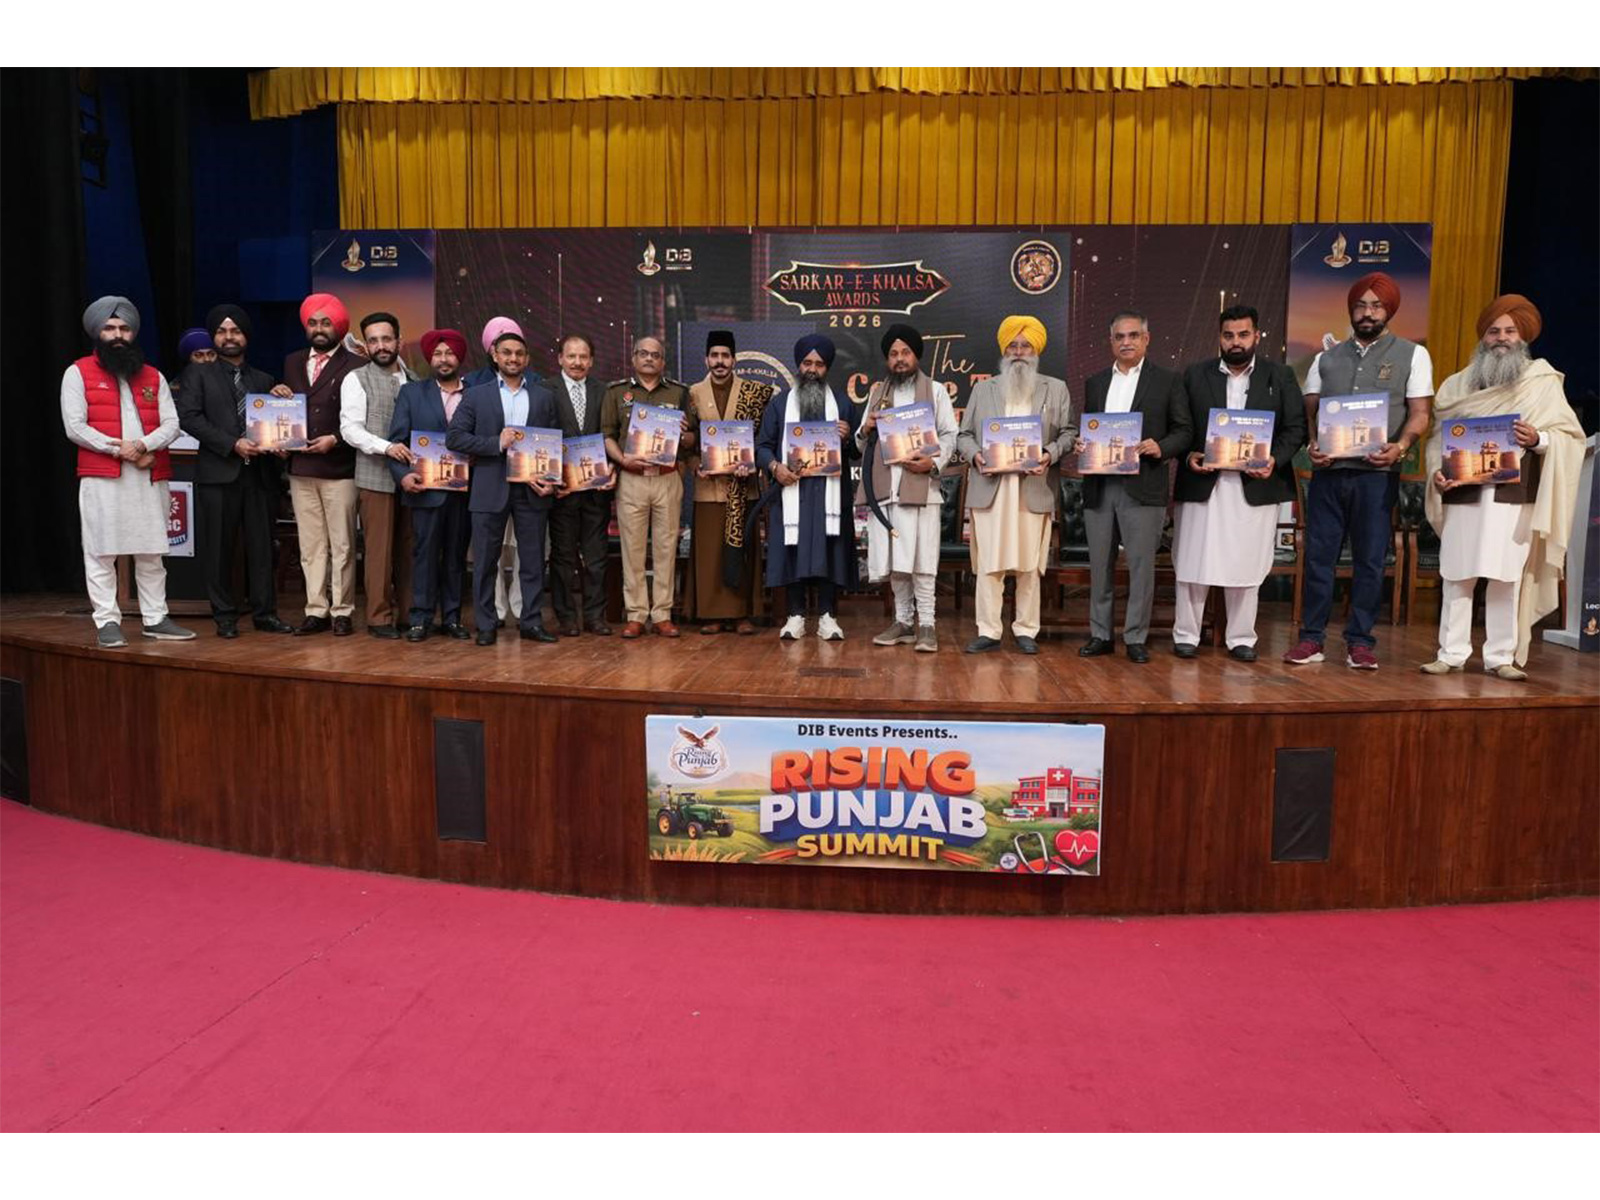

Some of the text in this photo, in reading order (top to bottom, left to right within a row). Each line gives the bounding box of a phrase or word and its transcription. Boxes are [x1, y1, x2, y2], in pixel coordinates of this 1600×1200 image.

[780, 273, 935, 291] SARKAR-E-KHALSA
[825, 292, 881, 306] AWARDS
[830, 315, 881, 328] 2026
[921, 334, 975, 380] The
[798, 724, 958, 740] DIB Events Presents..
[673, 752, 718, 767] Punjab
[771, 747, 976, 795] RISING
[760, 790, 988, 841] PUNJAB
[797, 833, 945, 861] SUMMIT
